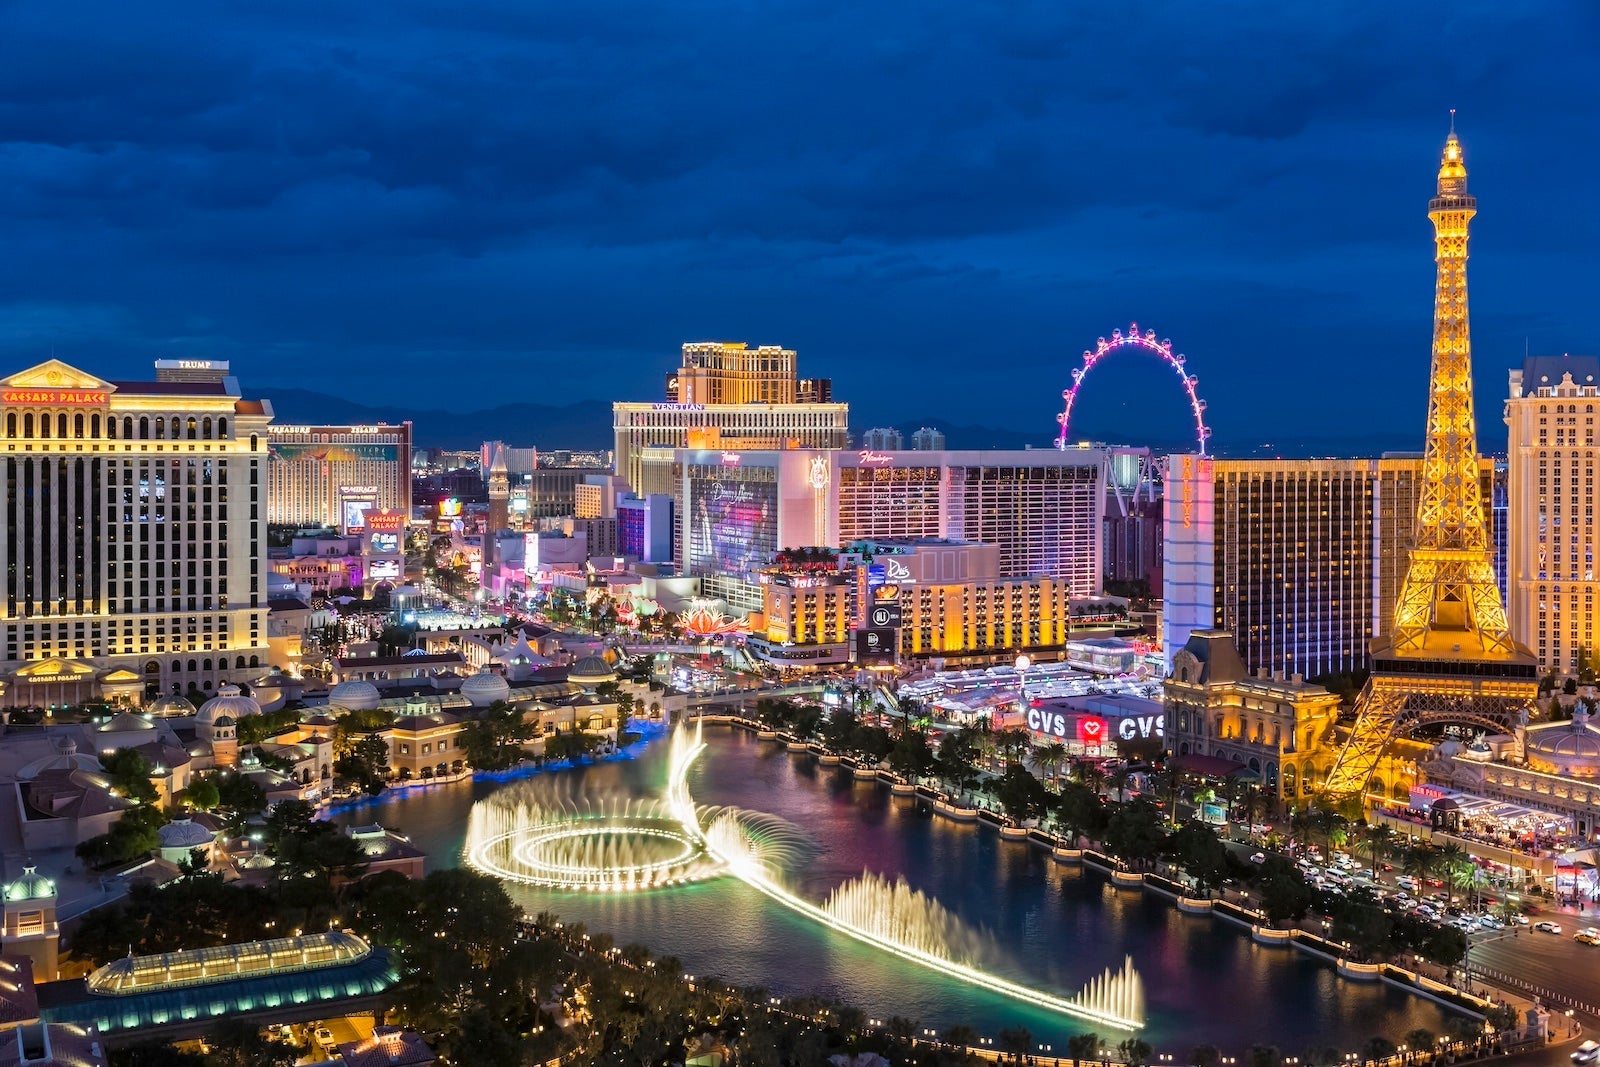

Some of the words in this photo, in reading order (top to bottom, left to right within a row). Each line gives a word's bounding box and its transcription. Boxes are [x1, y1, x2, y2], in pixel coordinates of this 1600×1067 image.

[179, 361, 211, 369] TRUMP
[2, 392, 56, 402] CAESARS
[60, 393, 105, 403] PALACE
[858, 450, 894, 465] Flamingo
[876, 611, 887, 622] BLT
[1028, 708, 1066, 737] CVS
[1425, 788, 1444, 799] PARK
